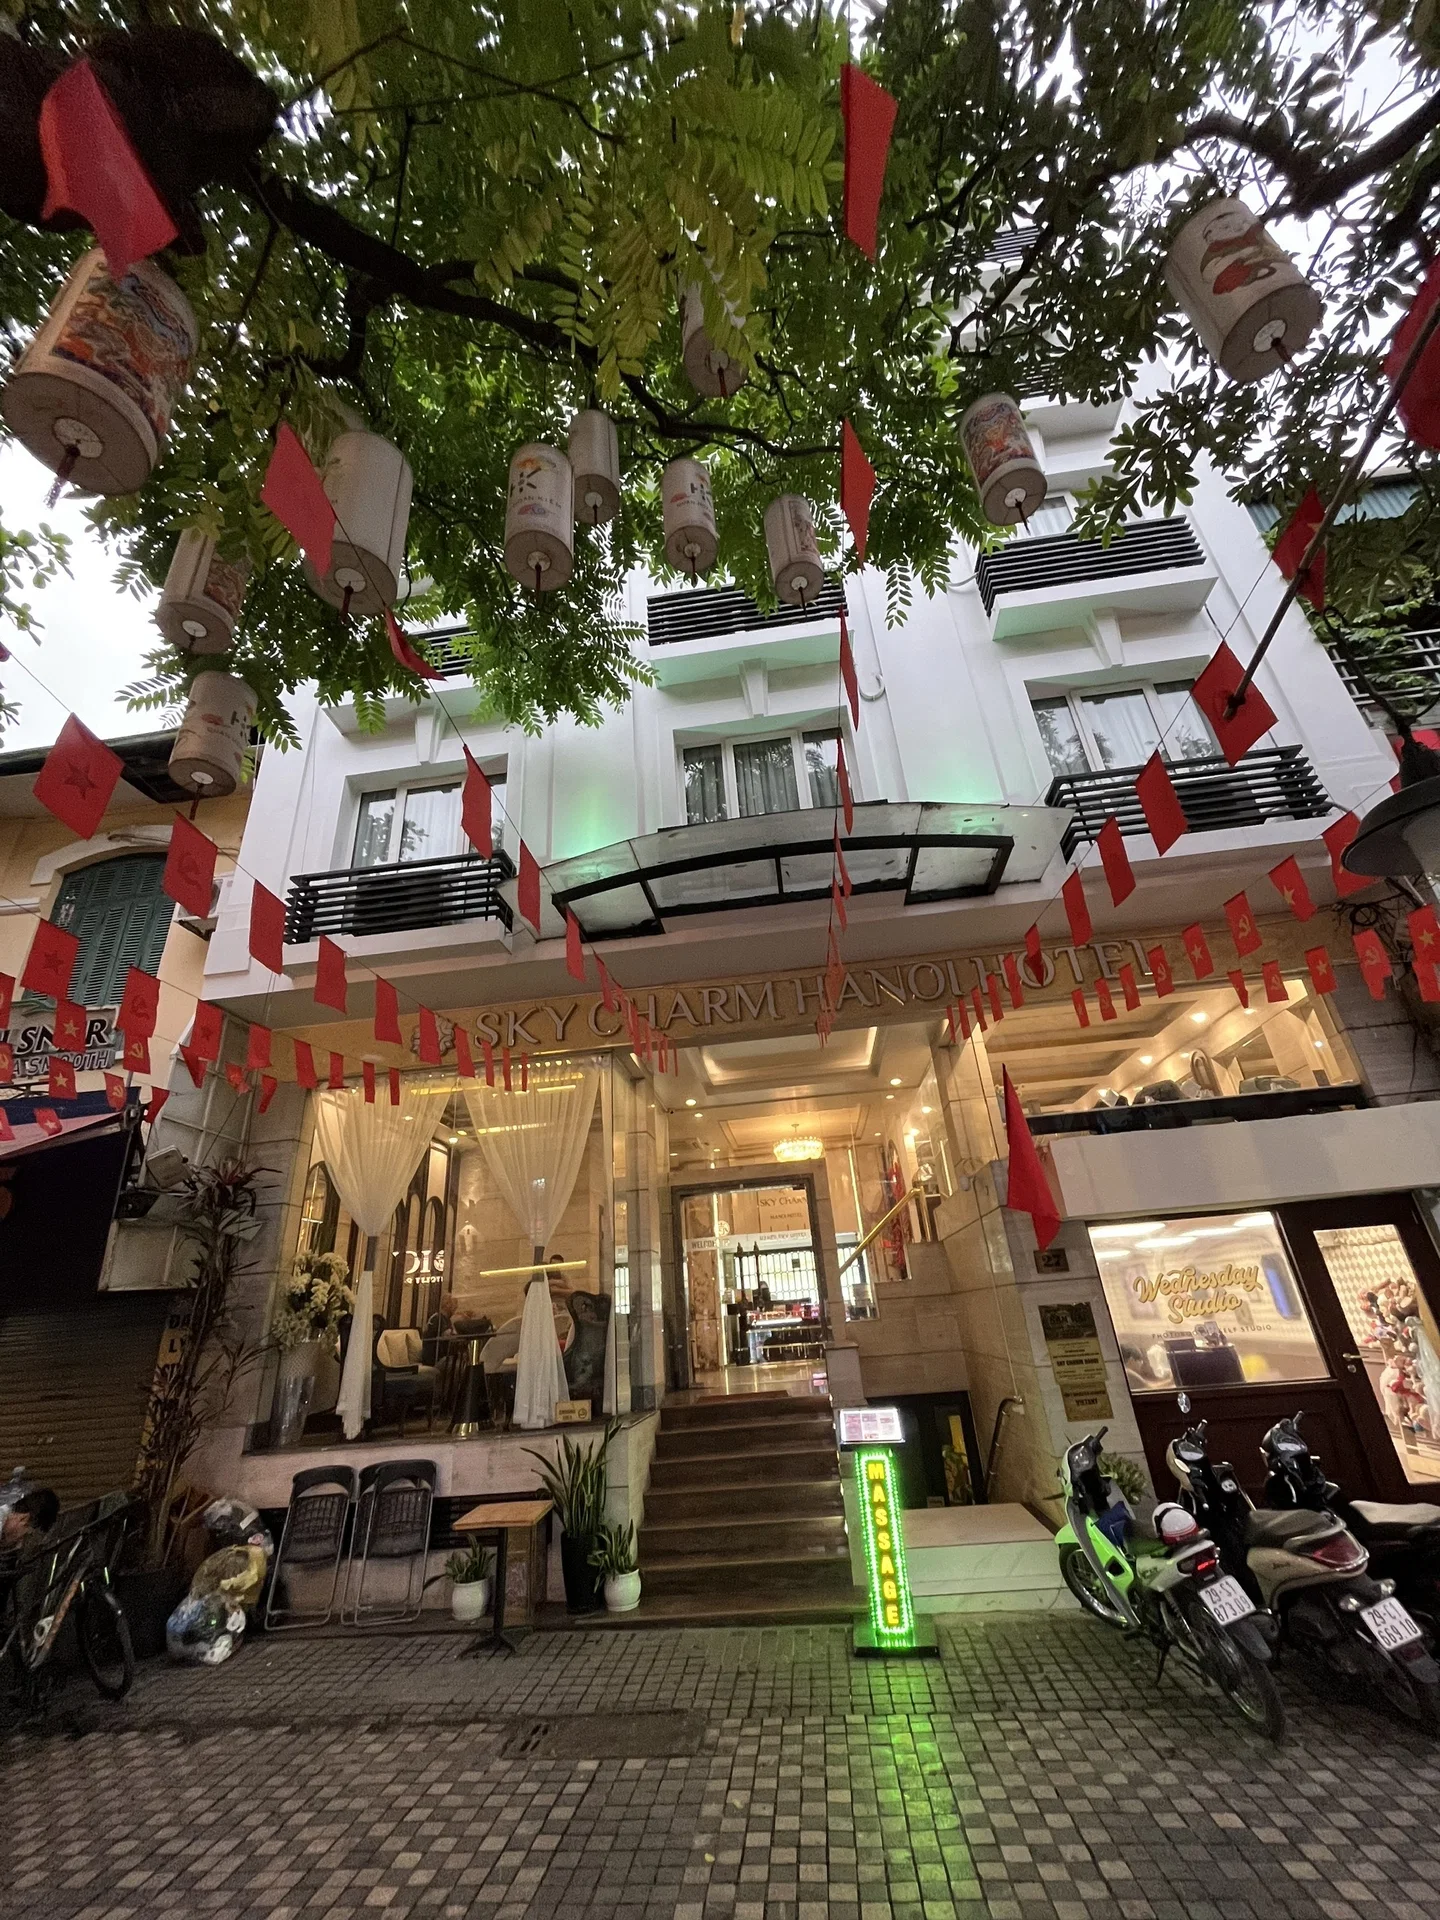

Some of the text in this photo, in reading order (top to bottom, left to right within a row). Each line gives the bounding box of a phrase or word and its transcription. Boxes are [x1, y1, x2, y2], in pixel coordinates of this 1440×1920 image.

[474, 937, 1155, 1048] SKY CHARM HANOI HOTEL
[26, 1049, 109, 1075] SOTH
[1133, 1263, 1264, 1304] Wednesday
[1167, 1290, 1243, 1325] Studio
[1240, 1323, 1272, 1333] STUDIO
[867, 1462, 900, 1626] MASSAGE
[1213, 1595, 1252, 1623] 873.09
[1367, 1601, 1402, 1628] 29-C1
[1377, 1618, 1419, 1647] 669.10
